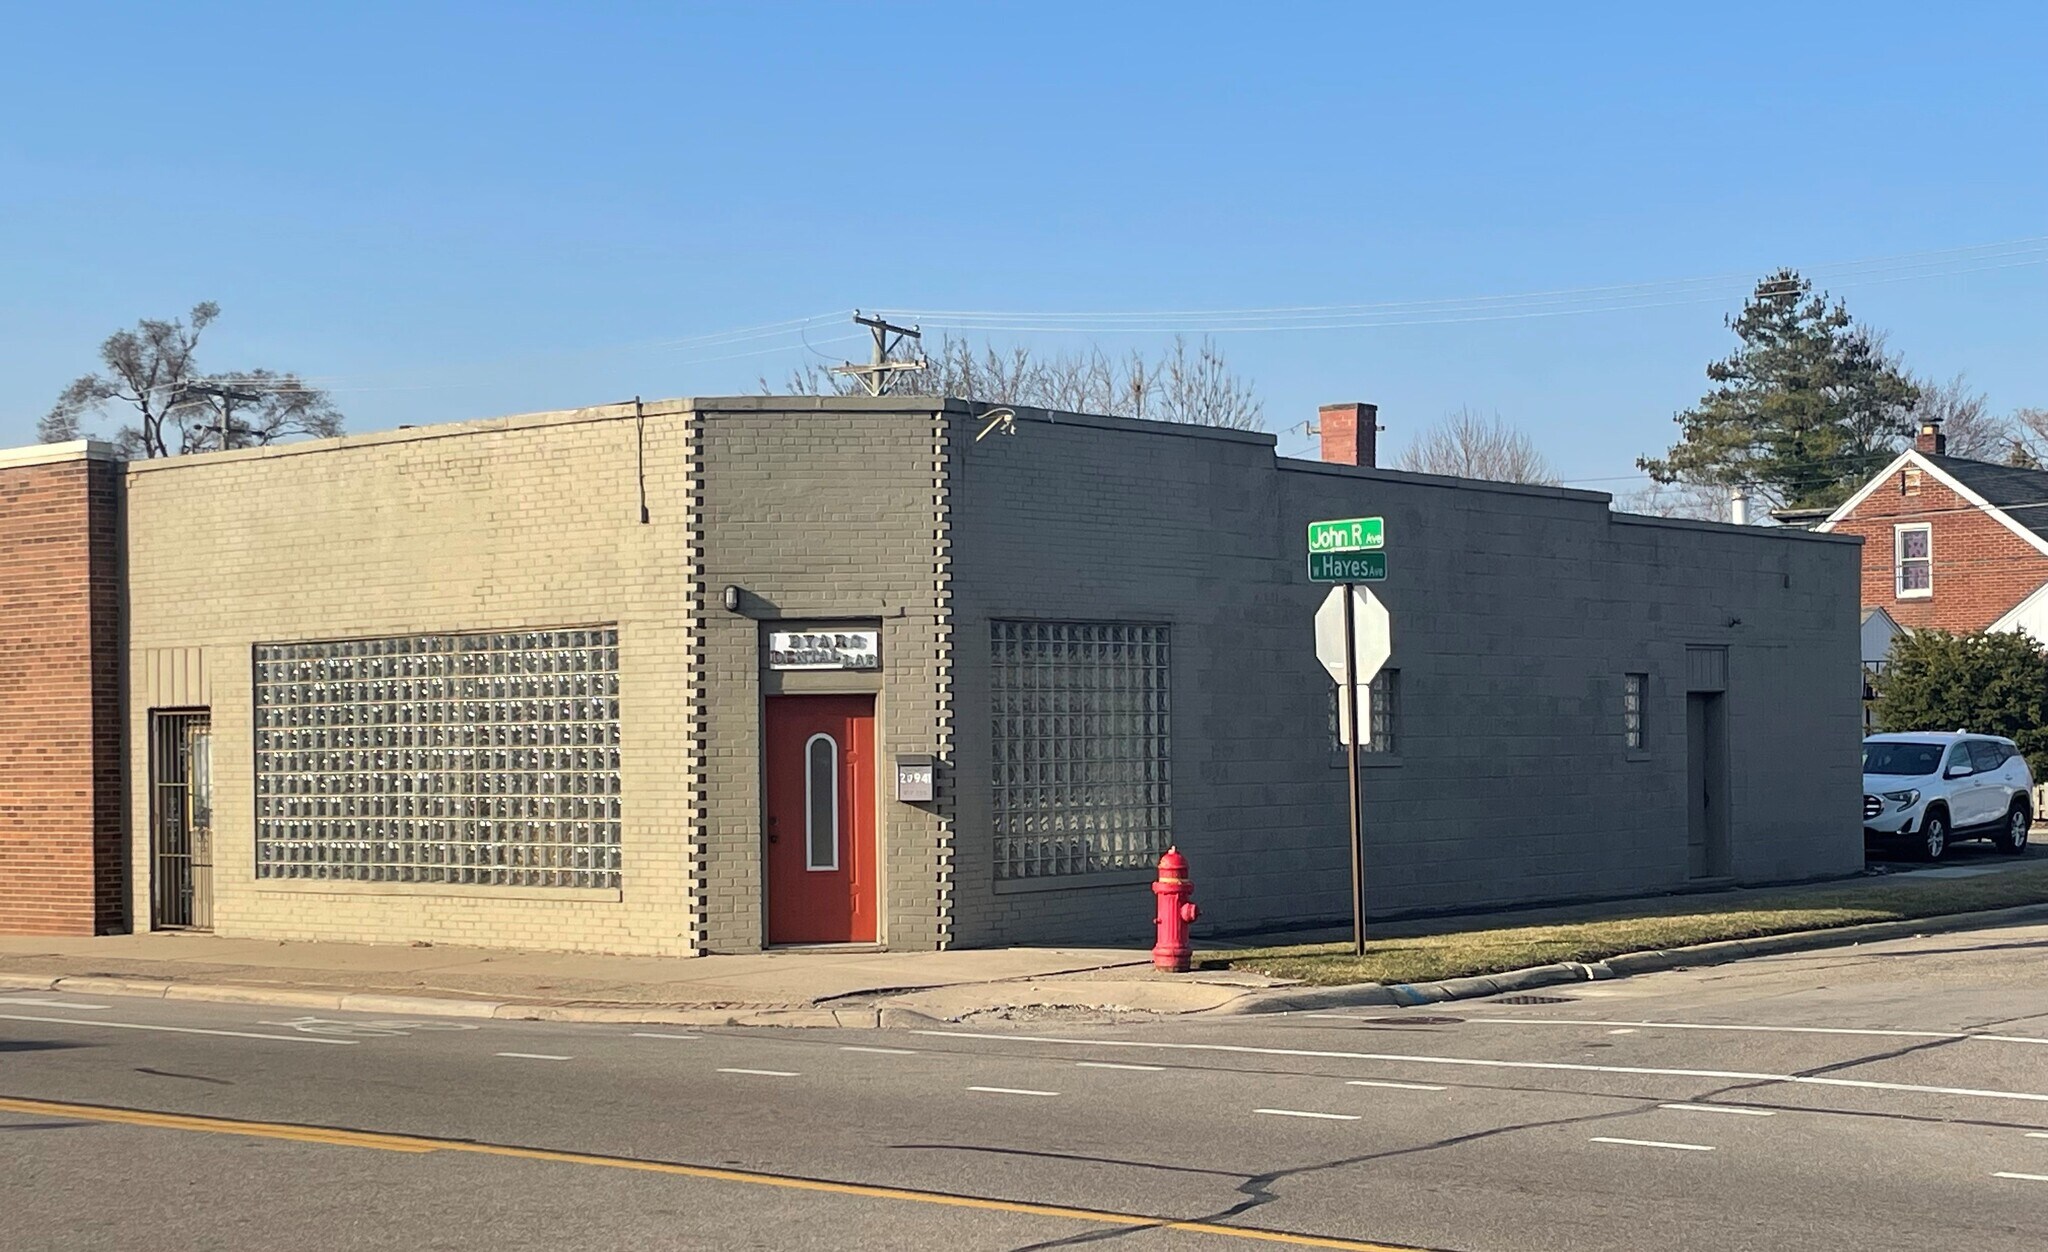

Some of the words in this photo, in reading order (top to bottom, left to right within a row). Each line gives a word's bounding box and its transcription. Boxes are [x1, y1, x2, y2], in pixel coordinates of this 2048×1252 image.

[1312, 526, 1348, 548] John
[1351, 523, 1362, 546] R
[1366, 533, 1381, 544] Ave
[1369, 566, 1383, 577] Ave
[770, 650, 841, 665] DENTAL
[843, 654, 878, 668] LAB
